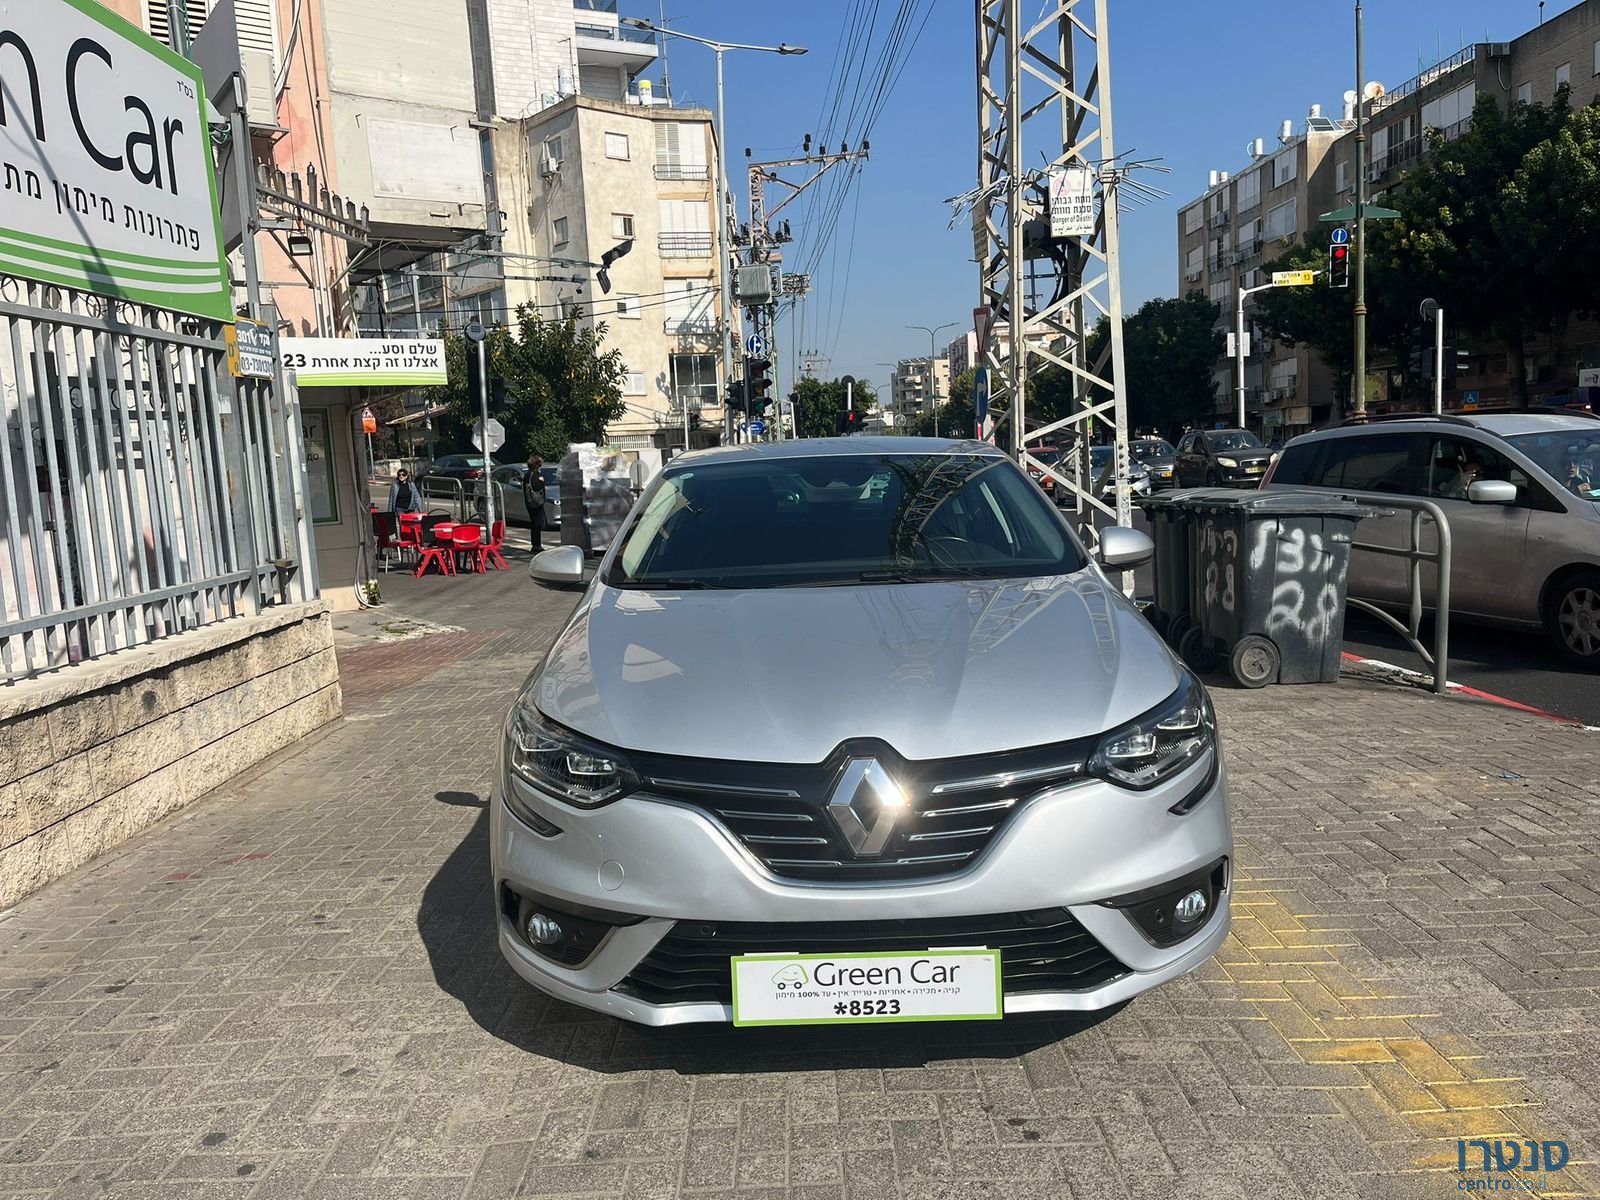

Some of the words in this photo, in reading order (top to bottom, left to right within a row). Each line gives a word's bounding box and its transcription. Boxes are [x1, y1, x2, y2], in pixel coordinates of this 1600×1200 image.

[176, 79, 194, 100] בס"ד
[65, 37, 184, 196] Car
[52, 178, 115, 223] מימון
[123, 204, 200, 252] פתרונות
[409, 343, 437, 354] שלם
[283, 353, 307, 368] 23
[311, 356, 349, 368] אחרת
[353, 357, 381, 371] קצת
[385, 356, 399, 368] זה
[404, 356, 438, 368] אצלנו
[813, 962, 902, 987] Green
[910, 959, 961, 985] Car
[775, 991, 796, 1000] מימון
[820, 990, 831, 998] עד
[837, 990, 849, 998] אין
[851, 989, 872, 997] טרייד
[878, 988, 906, 996] אחריות
[912, 987, 937, 996] מכירה
[942, 986, 961, 996] קניה
